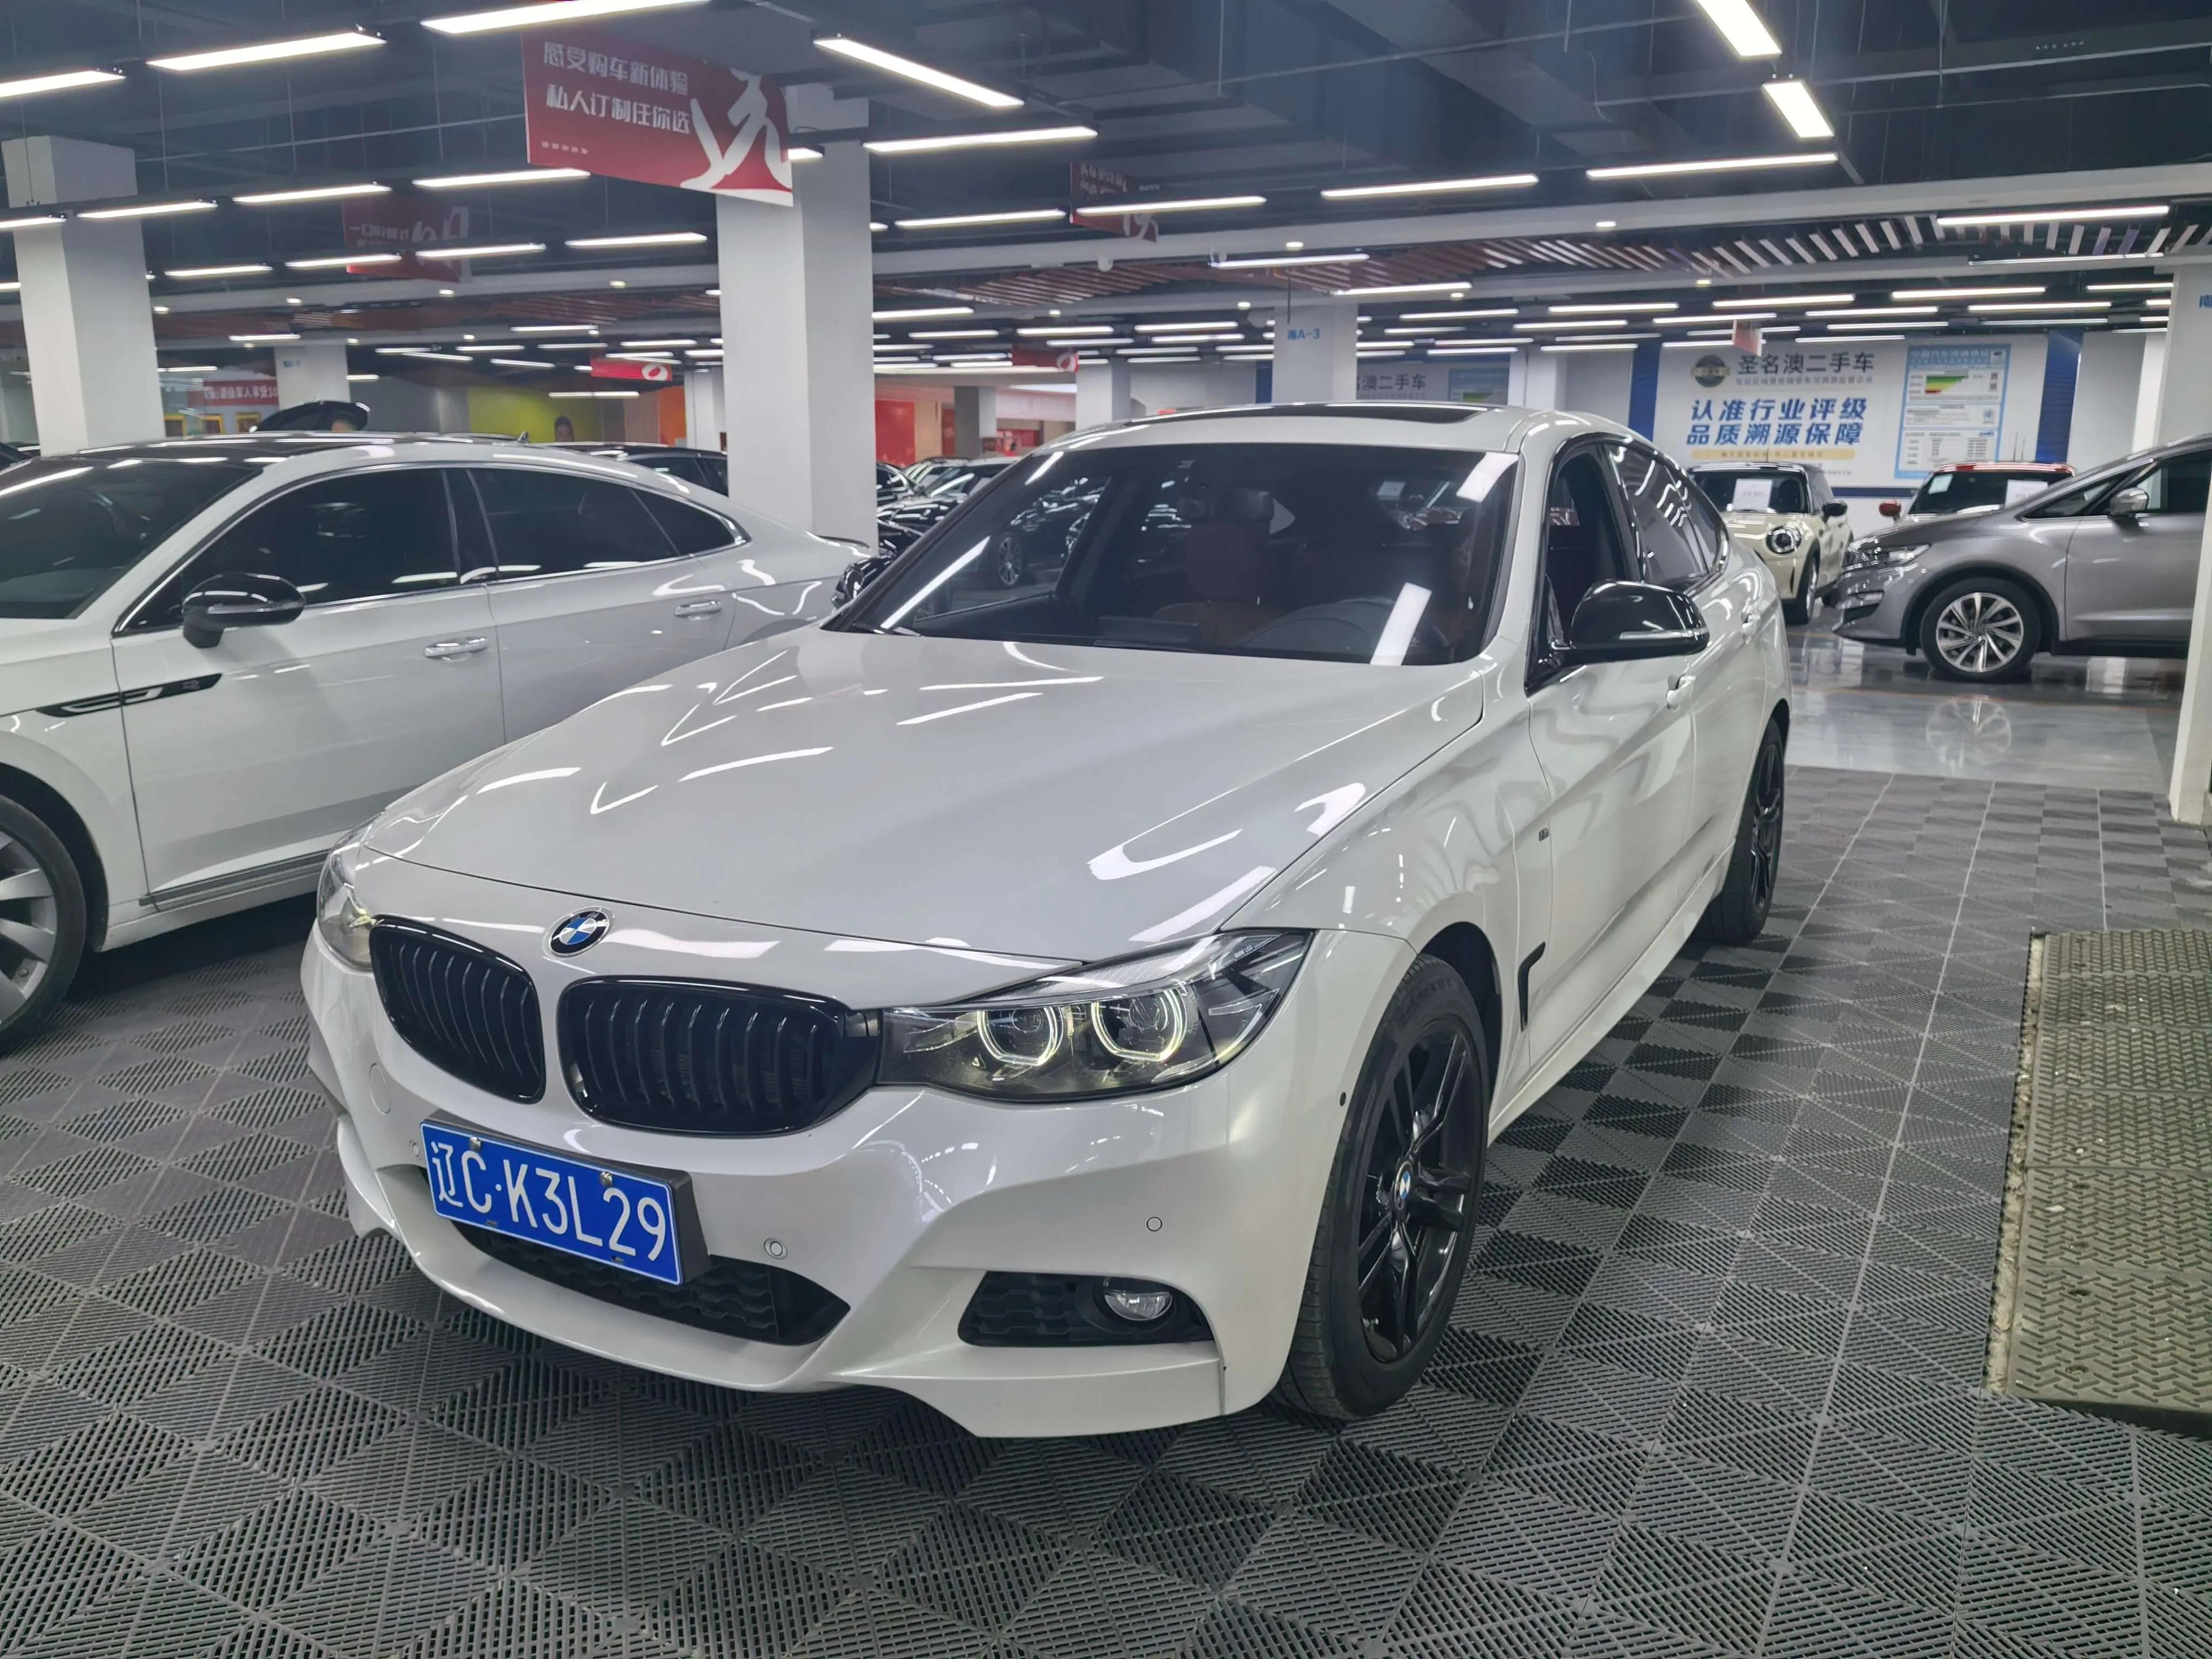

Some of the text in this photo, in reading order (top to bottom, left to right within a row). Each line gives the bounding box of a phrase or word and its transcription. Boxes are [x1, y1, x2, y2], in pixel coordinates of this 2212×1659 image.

[544, 41, 688, 96] 感受购车新体验
[546, 84, 690, 134] 私人订制任你选
[1738, 351, 1874, 374] 圣名澳二手车
[1357, 373, 1426, 391] 澳二手车
[1691, 397, 1867, 421] 认准行业评级
[1686, 422, 1863, 445] 品质溯源保障
[432, 1141, 666, 1262] 辽C·K3L29
